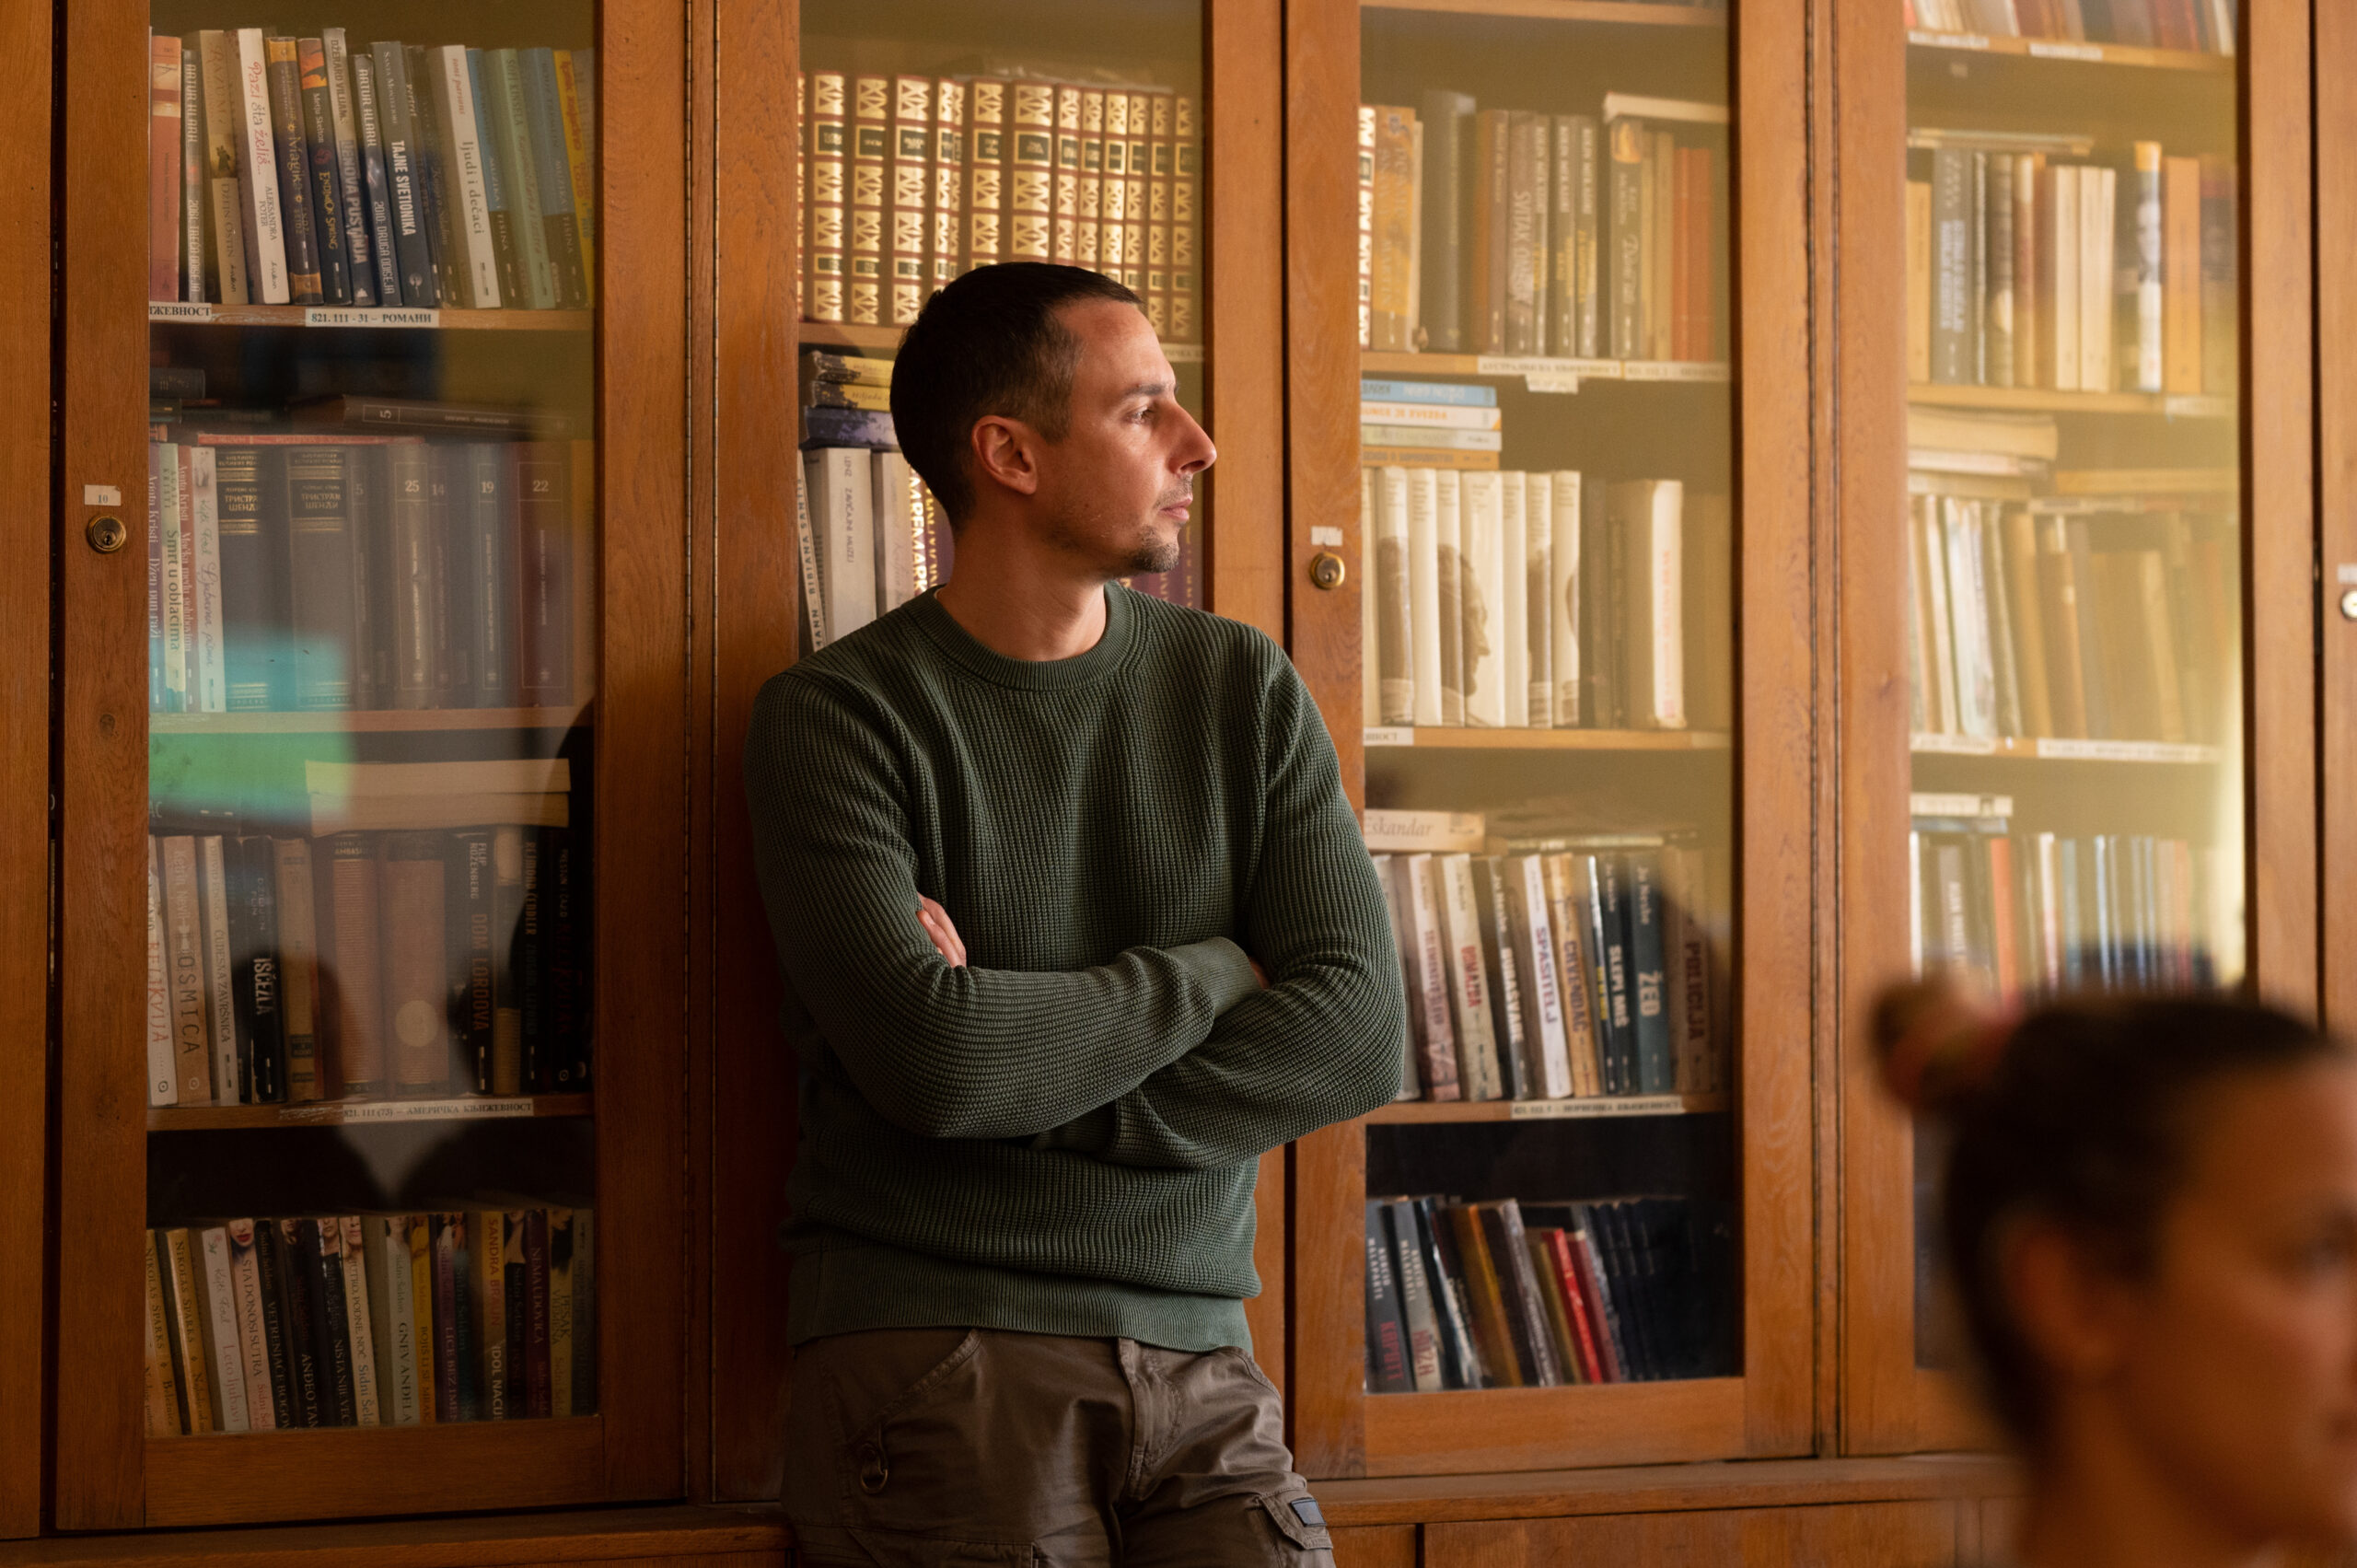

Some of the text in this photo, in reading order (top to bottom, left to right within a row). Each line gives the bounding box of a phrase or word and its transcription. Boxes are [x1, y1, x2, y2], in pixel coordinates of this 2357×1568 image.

[248, 62, 262, 99] Pazi
[331, 40, 344, 81] DŽERARD
[250, 102, 264, 126] šta
[316, 115, 326, 143] Skelton
[390, 140, 417, 236] TAJNE SVETIONIKA
[459, 141, 475, 176] ljudi
[467, 189, 485, 235] dečaci
[264, 184, 278, 241] ALEKSANDRA
[346, 197, 368, 264] PUSTINJA
[311, 313, 331, 323] 821.
[382, 314, 432, 323] РОМАНИ
[404, 480, 421, 493] 25
[481, 481, 494, 494] 19
[532, 480, 549, 493] 22
[843, 456, 853, 477] LENZ
[302, 494, 342, 502] ТРИСТРАМ
[306, 501, 339, 510] ШЕНДИ
[432, 483, 445, 496] 14
[802, 535, 816, 595] BIBIANA
[846, 535, 854, 563] MUZEJ
[166, 529, 182, 651] Smrt u oblacima
[469, 842, 480, 900] ROZENBERG
[477, 842, 488, 866] FILIP
[470, 913, 489, 949] DOM
[252, 958, 276, 1015] IŠČEZLA
[1536, 926, 1558, 1025] SPASITELJ
[1608, 945, 1630, 1028] SLEPI MIŠ
[1685, 940, 1706, 1040] POLICIJA
[176, 956, 201, 1054] OSMICA
[217, 982, 231, 1043] ZAVRŠNICA
[406, 1104, 459, 1115] АМЕРИЧКА
[463, 1102, 531, 1114] КЊИЖЕВНОСТ
[175, 1241, 194, 1343] NIKOLAS SPARKS
[488, 1219, 501, 1327] SANDRA BRAUN
[152, 1305, 164, 1349] SPARKS
[559, 1295, 572, 1340] PESAK
[248, 1334, 261, 1377] SUTRA
[398, 1322, 409, 1361] GNEV
[445, 1327, 457, 1384] LICE BEZ
[491, 1345, 502, 1376] IDOL
[1380, 1320, 1404, 1381] KAPUTT
[301, 1353, 315, 1400] ANĐEO
[357, 1365, 370, 1396] Sidni
